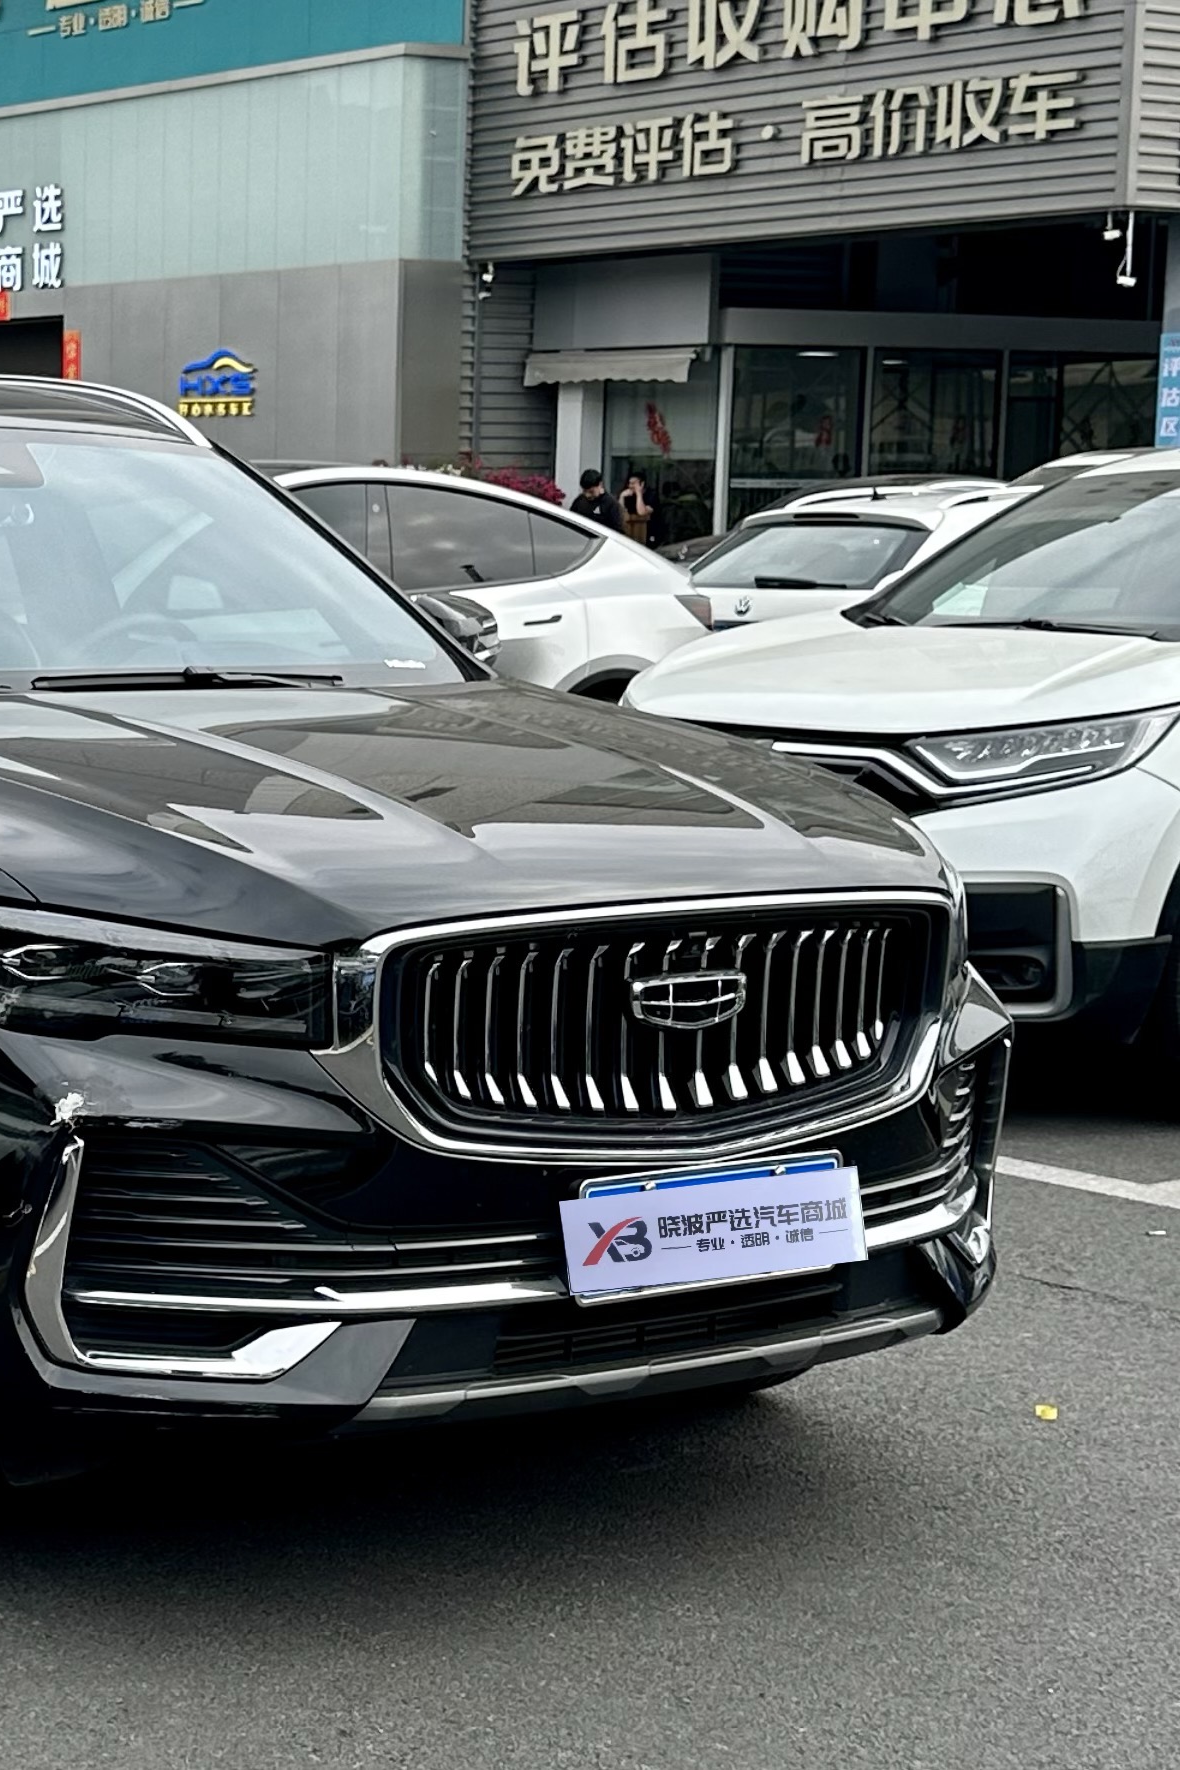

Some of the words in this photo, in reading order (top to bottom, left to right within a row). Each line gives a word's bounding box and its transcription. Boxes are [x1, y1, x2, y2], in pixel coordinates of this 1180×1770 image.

[511, 71, 1082, 197] 免费评估·高价收车
[657, 1197, 848, 1239] 晓波严选汽车商城
[696, 1228, 814, 1253] 专业·透明·诚信
